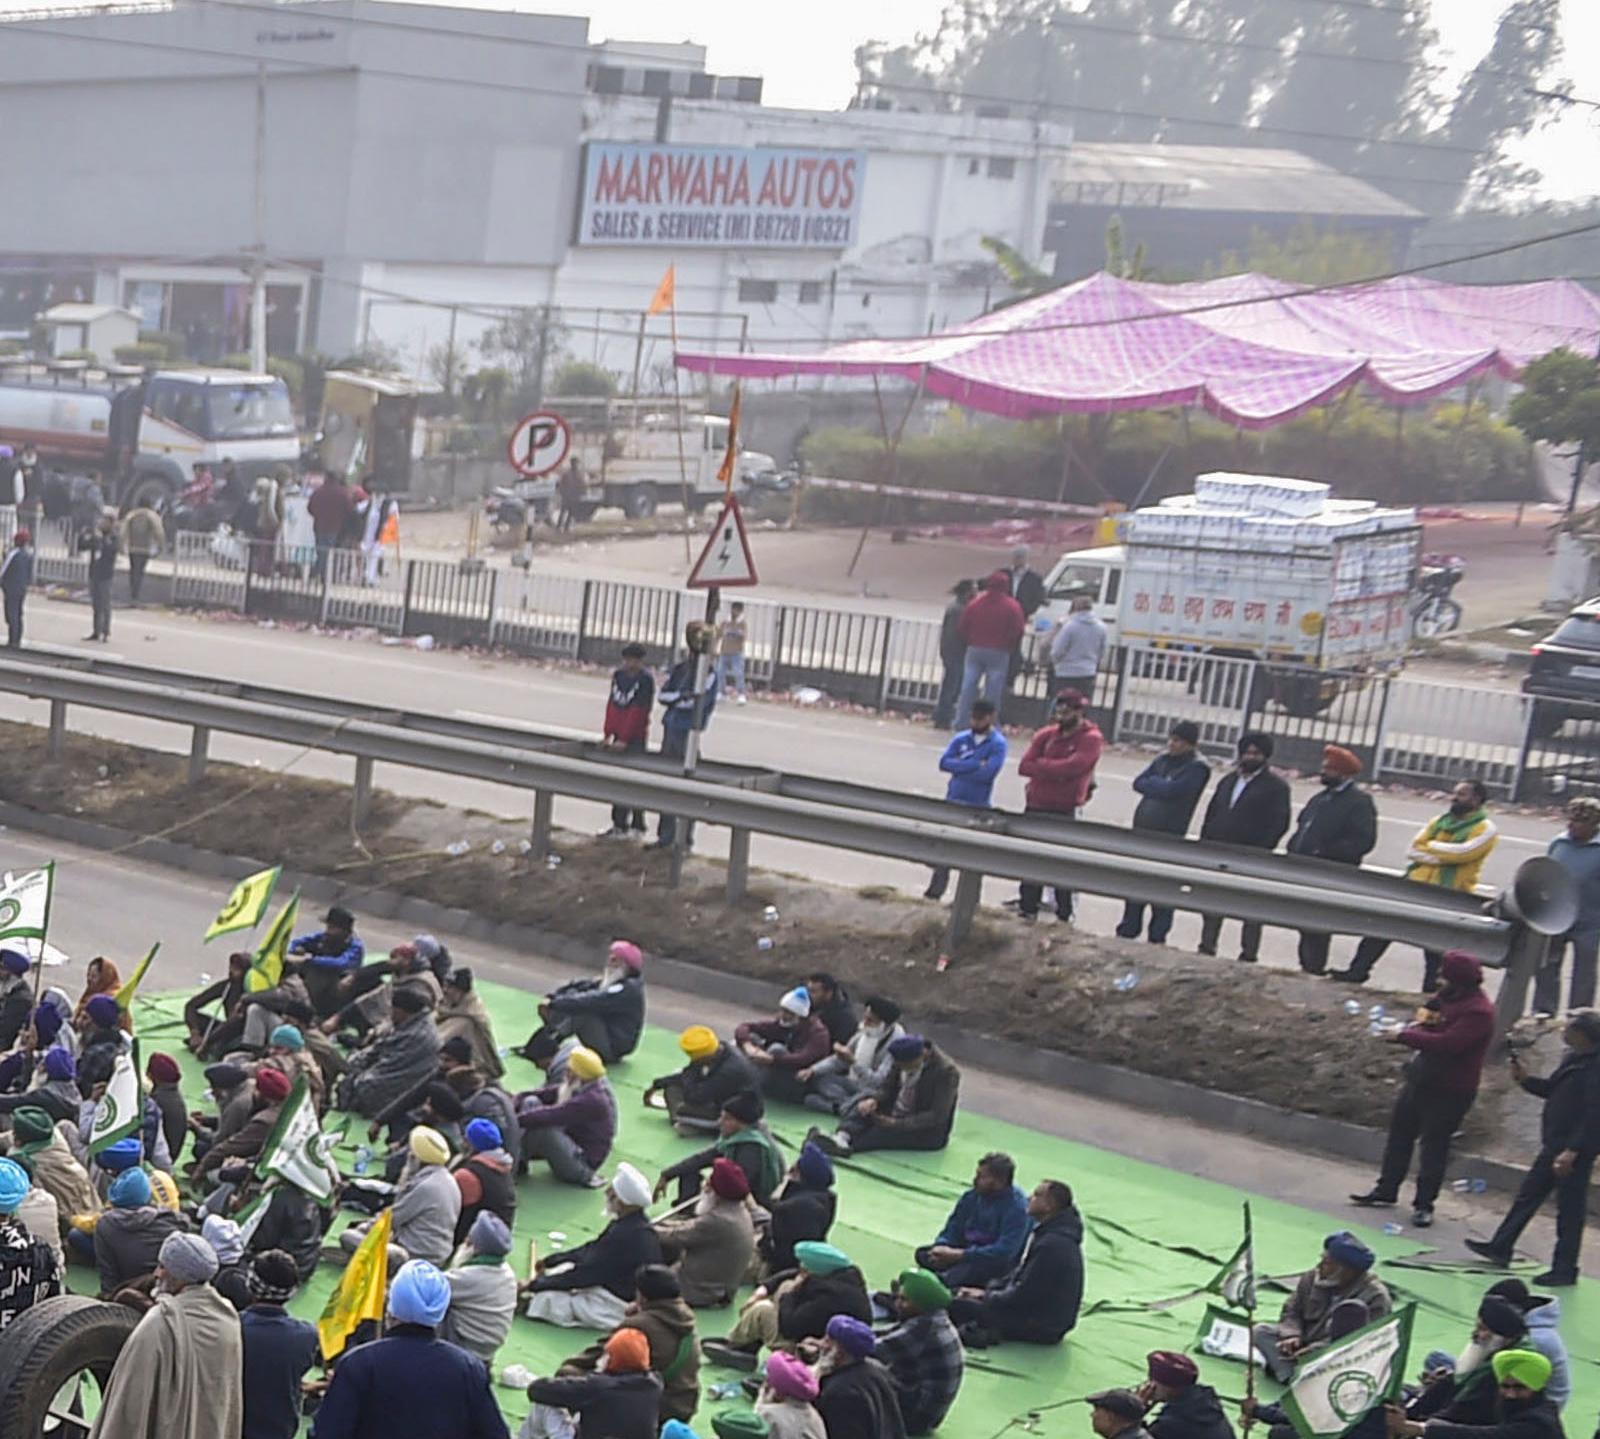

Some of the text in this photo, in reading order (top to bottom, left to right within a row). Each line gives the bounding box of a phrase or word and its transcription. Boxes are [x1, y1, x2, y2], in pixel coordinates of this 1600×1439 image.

[595, 152, 856, 209] MARWAHA AUTOS
[592, 211, 640, 239] SALES
[658, 212, 721, 240] SERVICE
